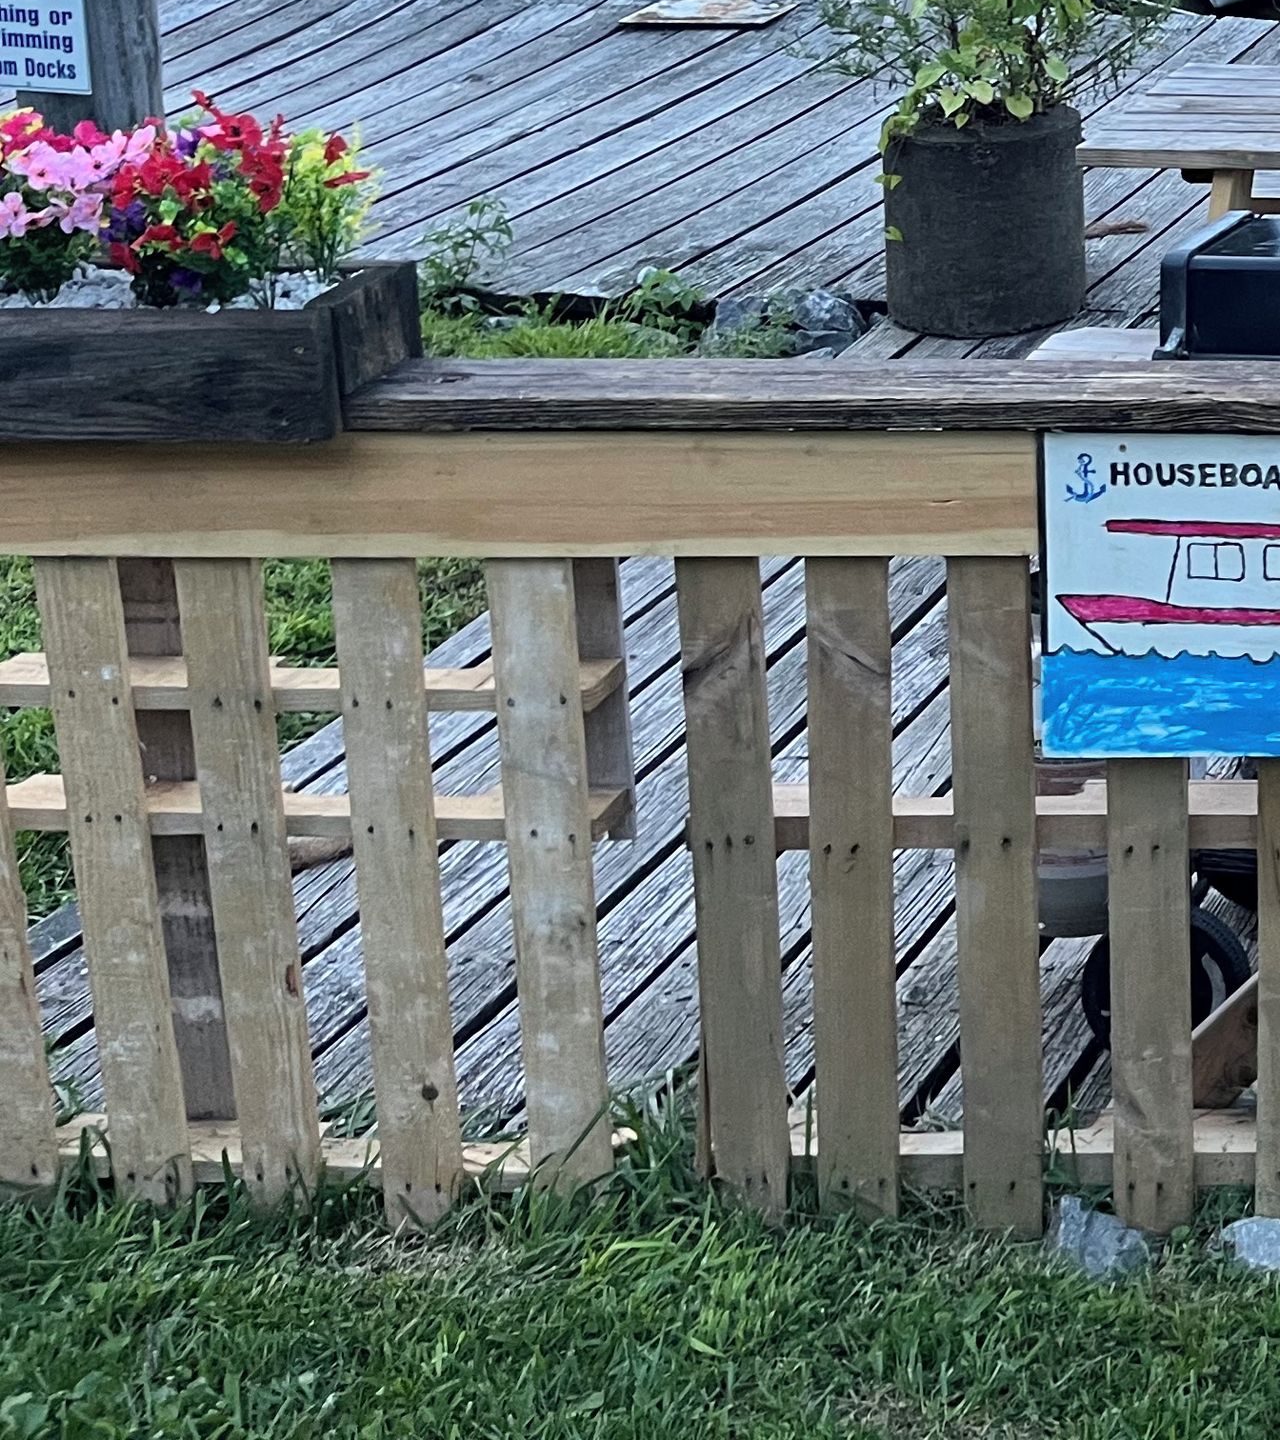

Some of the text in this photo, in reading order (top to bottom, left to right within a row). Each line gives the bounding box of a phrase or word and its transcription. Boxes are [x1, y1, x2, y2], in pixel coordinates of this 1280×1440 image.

[49, 10, 73, 26] or
[0, 28, 74, 54] imming
[25, 58, 77, 80] Docks
